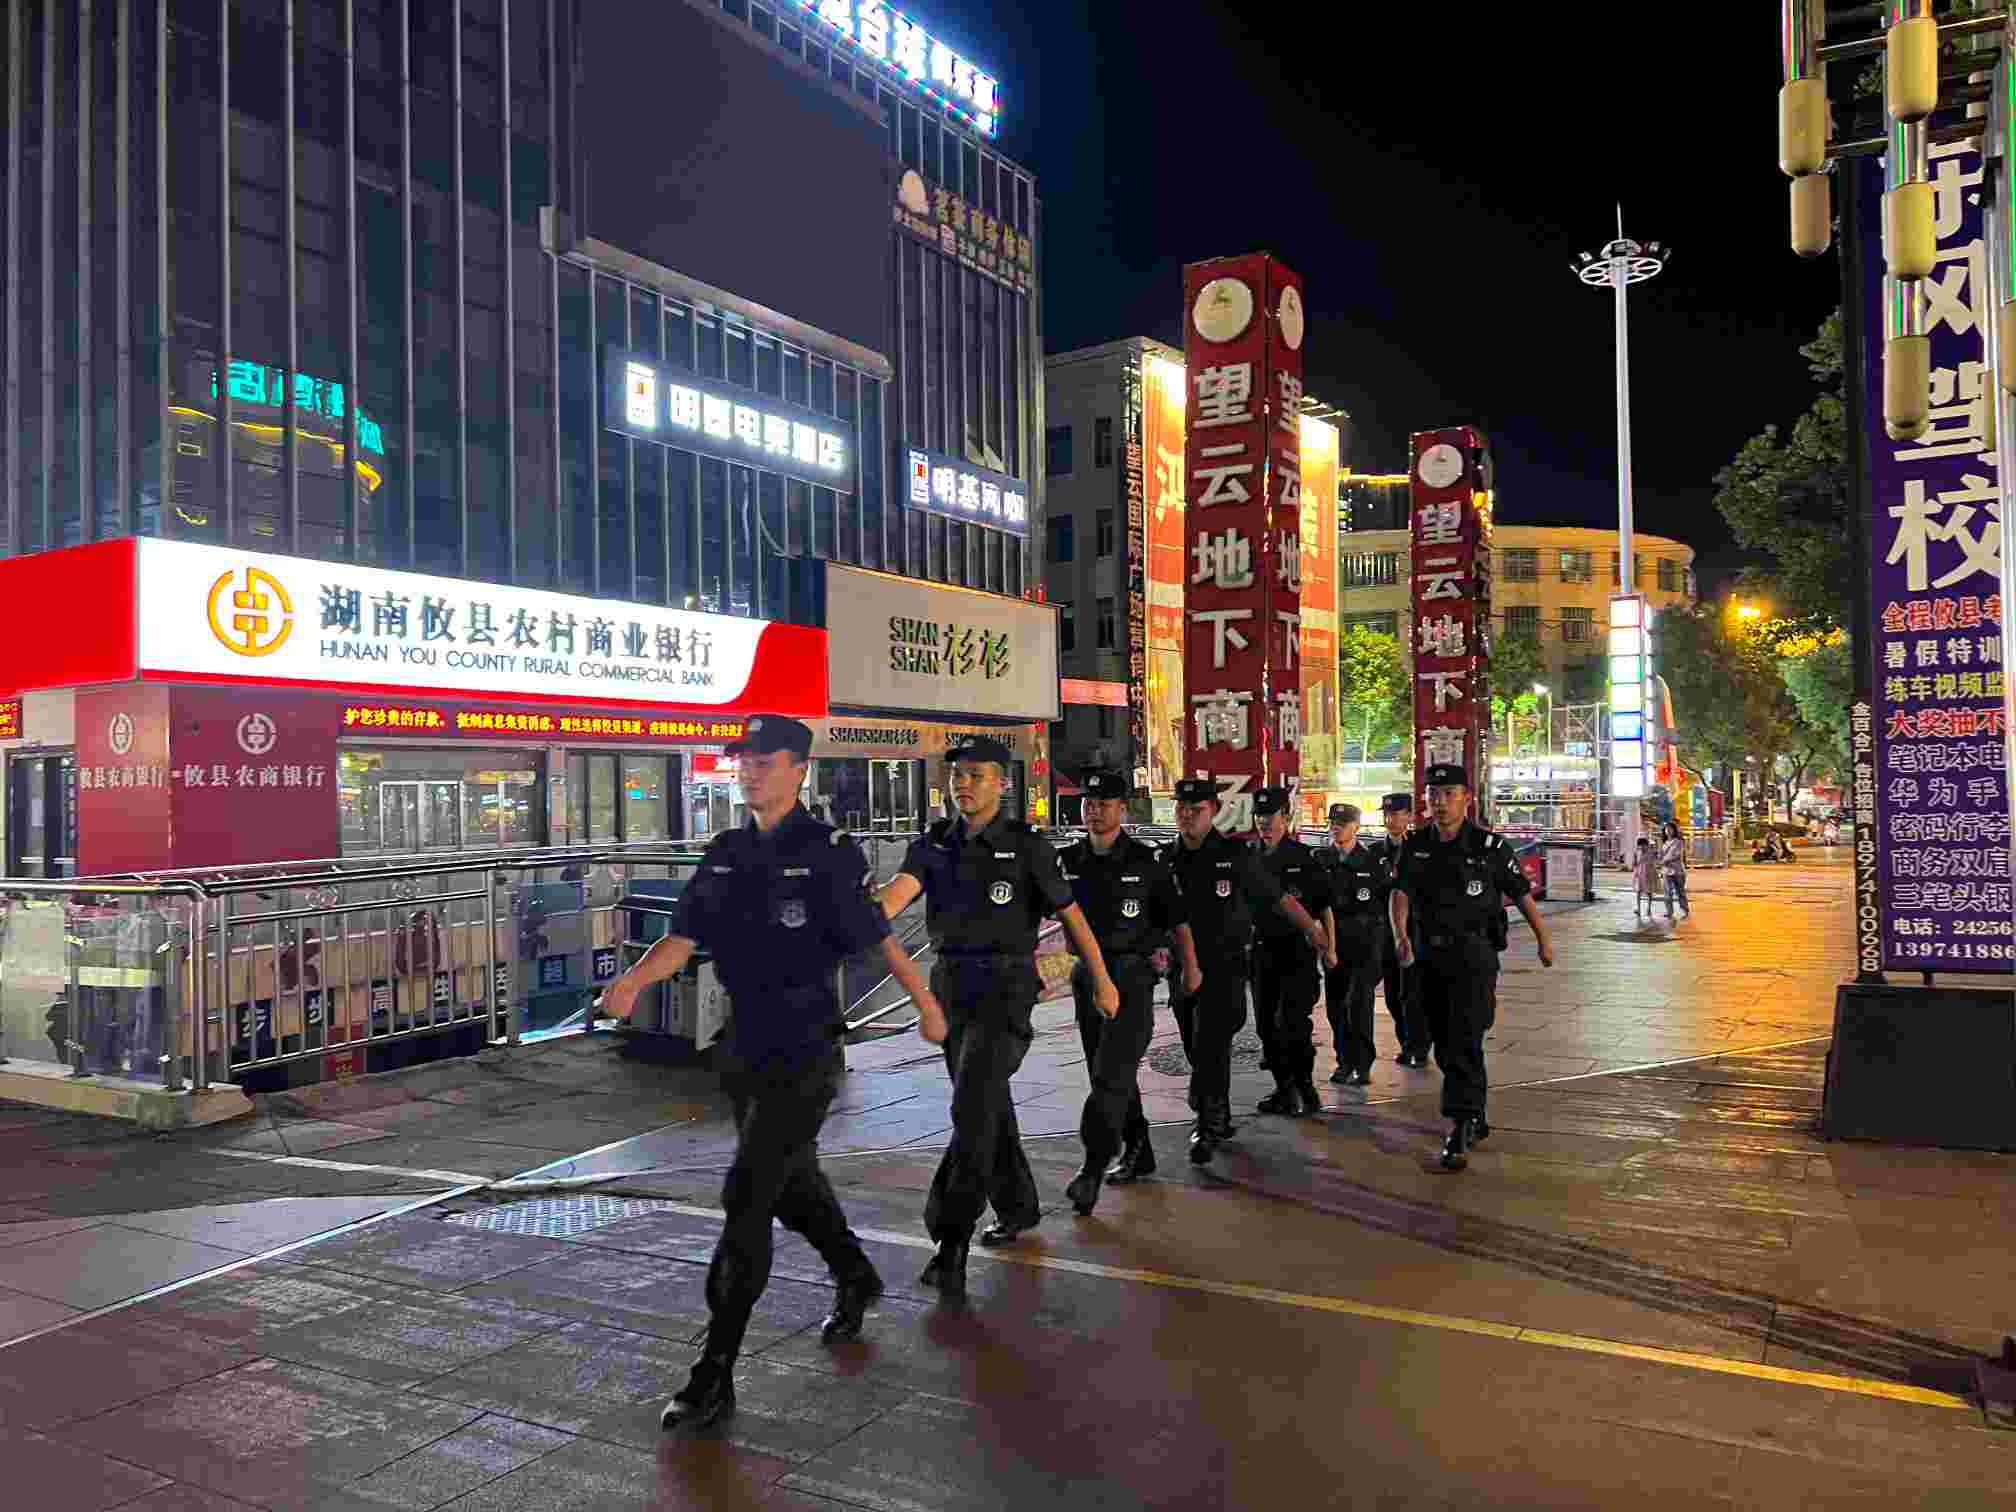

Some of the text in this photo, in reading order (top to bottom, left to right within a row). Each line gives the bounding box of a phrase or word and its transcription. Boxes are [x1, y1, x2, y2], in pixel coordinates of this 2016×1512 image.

[319, 583, 713, 668] 湖南攸县农村商业银行
[889, 615, 939, 646] SHAN
[320, 640, 713, 687] HUNAN YOU COUNTY RURAL COMMERCIAL BANK
[889, 645, 941, 676] SHAN
[942, 623, 1010, 679] 杉杉
[1417, 500, 1468, 818] 望云地下商
[1888, 741, 2008, 773] 笔记本电
[79, 767, 164, 789] 攸县农商银行
[183, 764, 326, 788] 攸县农商银行
[1888, 777, 2000, 808] 华为手
[1888, 812, 2010, 842] 密码行李
[1890, 847, 2010, 877] 商务双肩
[1857, 827, 1880, 972] 18974100668
